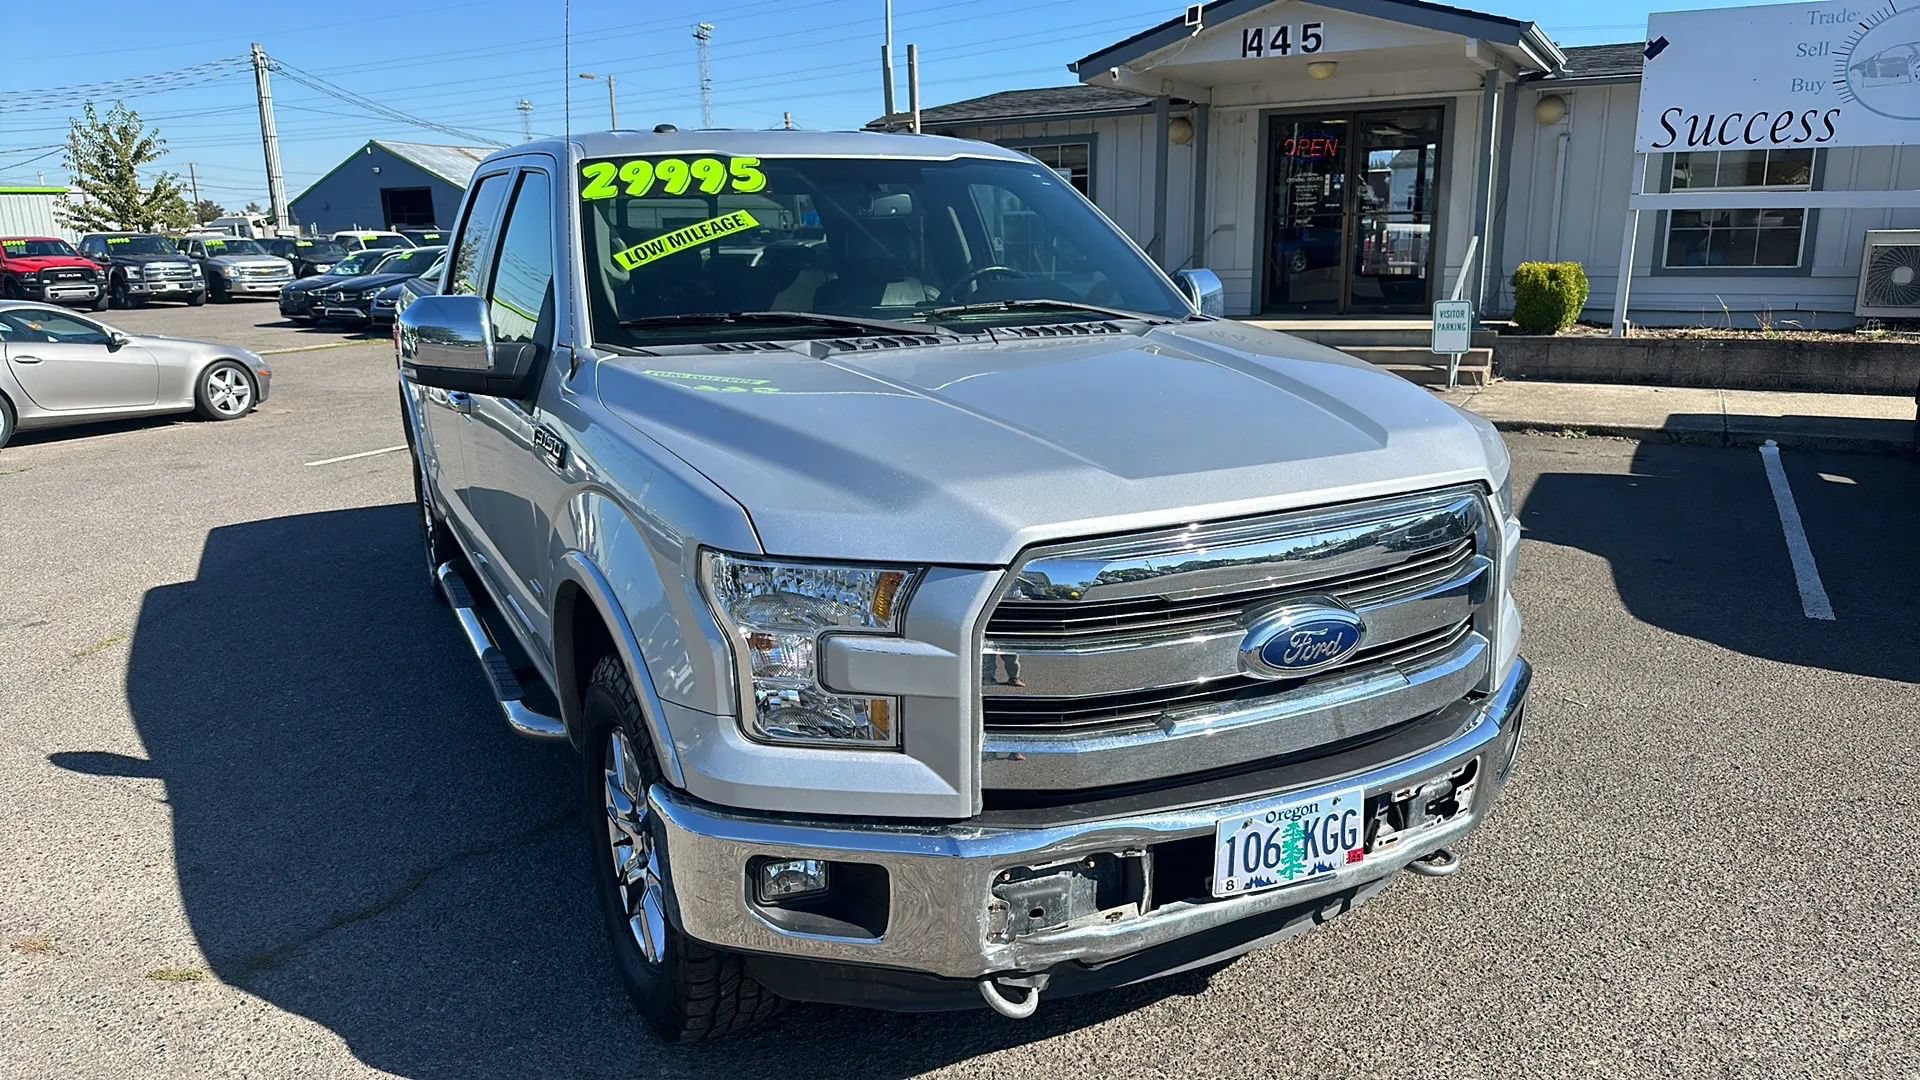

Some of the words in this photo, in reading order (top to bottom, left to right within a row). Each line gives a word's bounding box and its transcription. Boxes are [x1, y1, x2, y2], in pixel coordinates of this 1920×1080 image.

[1807, 8, 1856, 25] Trade
[1241, 22, 1323, 58] 1445
[1796, 41, 1829, 58] Sell
[1791, 78, 1826, 95] Buy
[1651, 106, 1841, 149] Success
[1284, 138, 1339, 157] OPEN
[581, 156, 767, 201] 29995
[624, 239, 664, 266] LOW
[669, 213, 744, 248] MILEAGE
[1440, 310, 1465, 319] VISITOR
[1437, 322, 1466, 332] PARKING
[1283, 628, 1343, 665] Ford
[1265, 802, 1319, 824] Oregon
[1226, 827, 1282, 878] 106
[1303, 809, 1358, 861] KGG
[1225, 879, 1235, 891] 8
